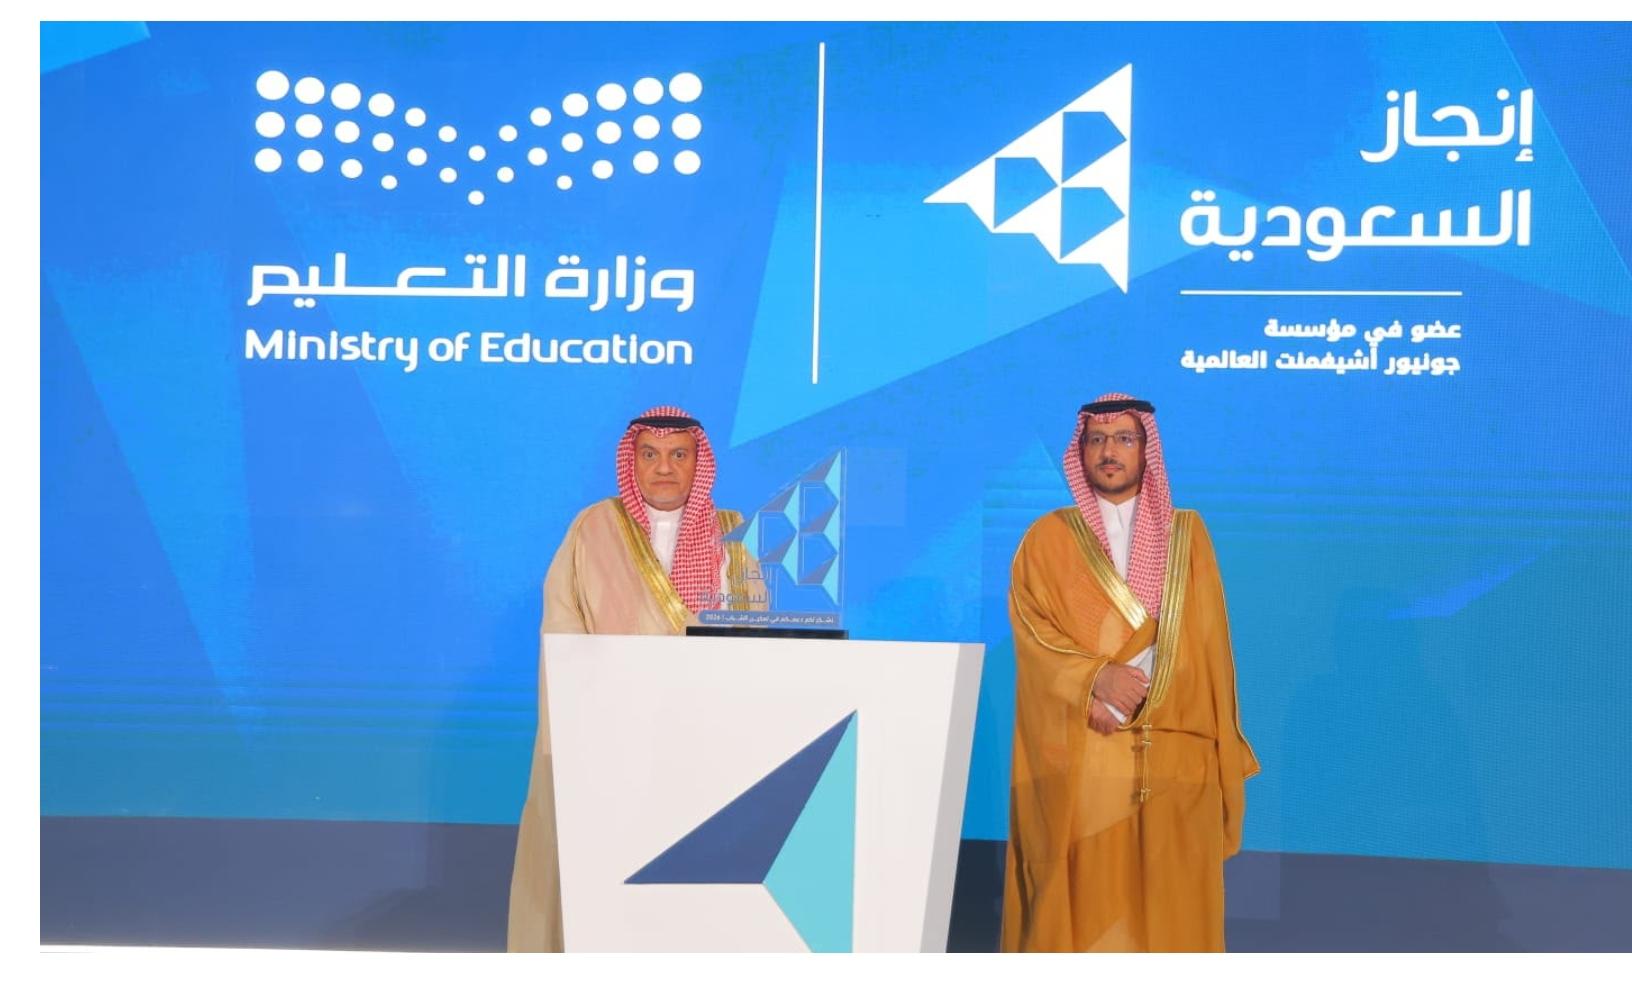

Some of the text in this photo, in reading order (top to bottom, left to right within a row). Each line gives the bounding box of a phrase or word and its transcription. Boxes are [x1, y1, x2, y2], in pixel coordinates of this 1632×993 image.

[1360, 89, 1533, 163] إنجاز
[1180, 189, 1531, 262] السعودية
[247, 253, 694, 312] وزارة التعليم
[245, 329, 692, 372] Ministry of Education
[1264, 319, 1461, 343] عضو في مؤسسة
[1181, 341, 1460, 375] جونيور أشيفمنت العالمية
